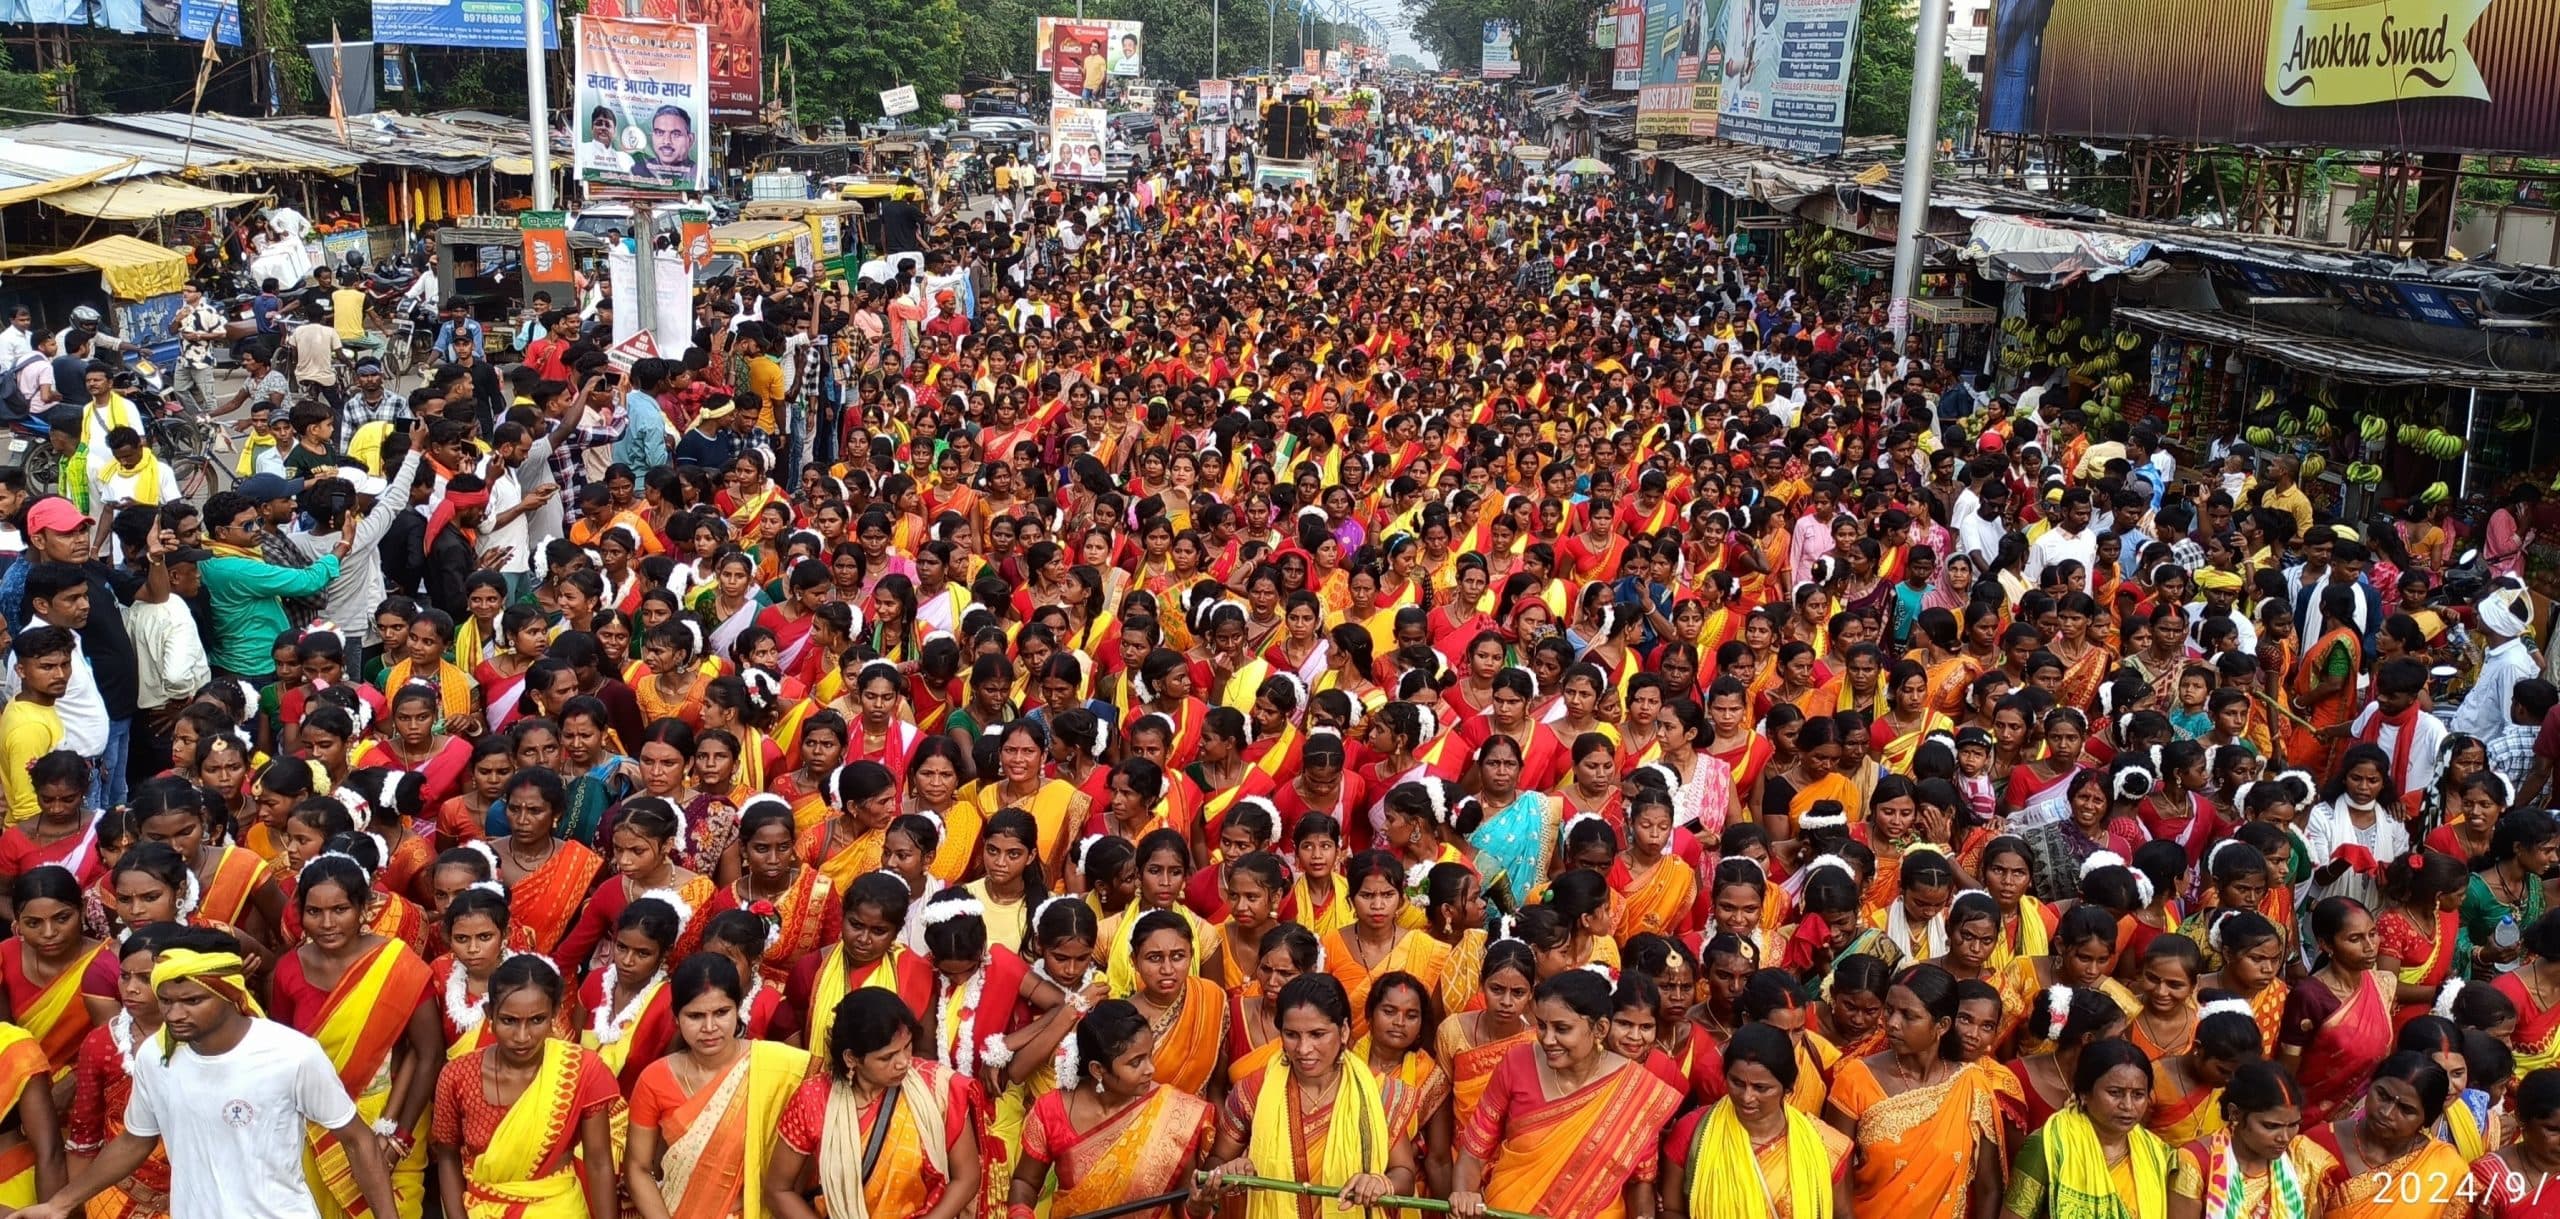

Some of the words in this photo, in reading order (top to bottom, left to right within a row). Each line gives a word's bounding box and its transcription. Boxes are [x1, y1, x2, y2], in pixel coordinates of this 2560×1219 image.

[2287, 22, 2371, 73] Anokha
[2376, 13, 2451, 68] Swad
[624, 77, 660, 96] आपके
[662, 82, 692, 98] साथ
